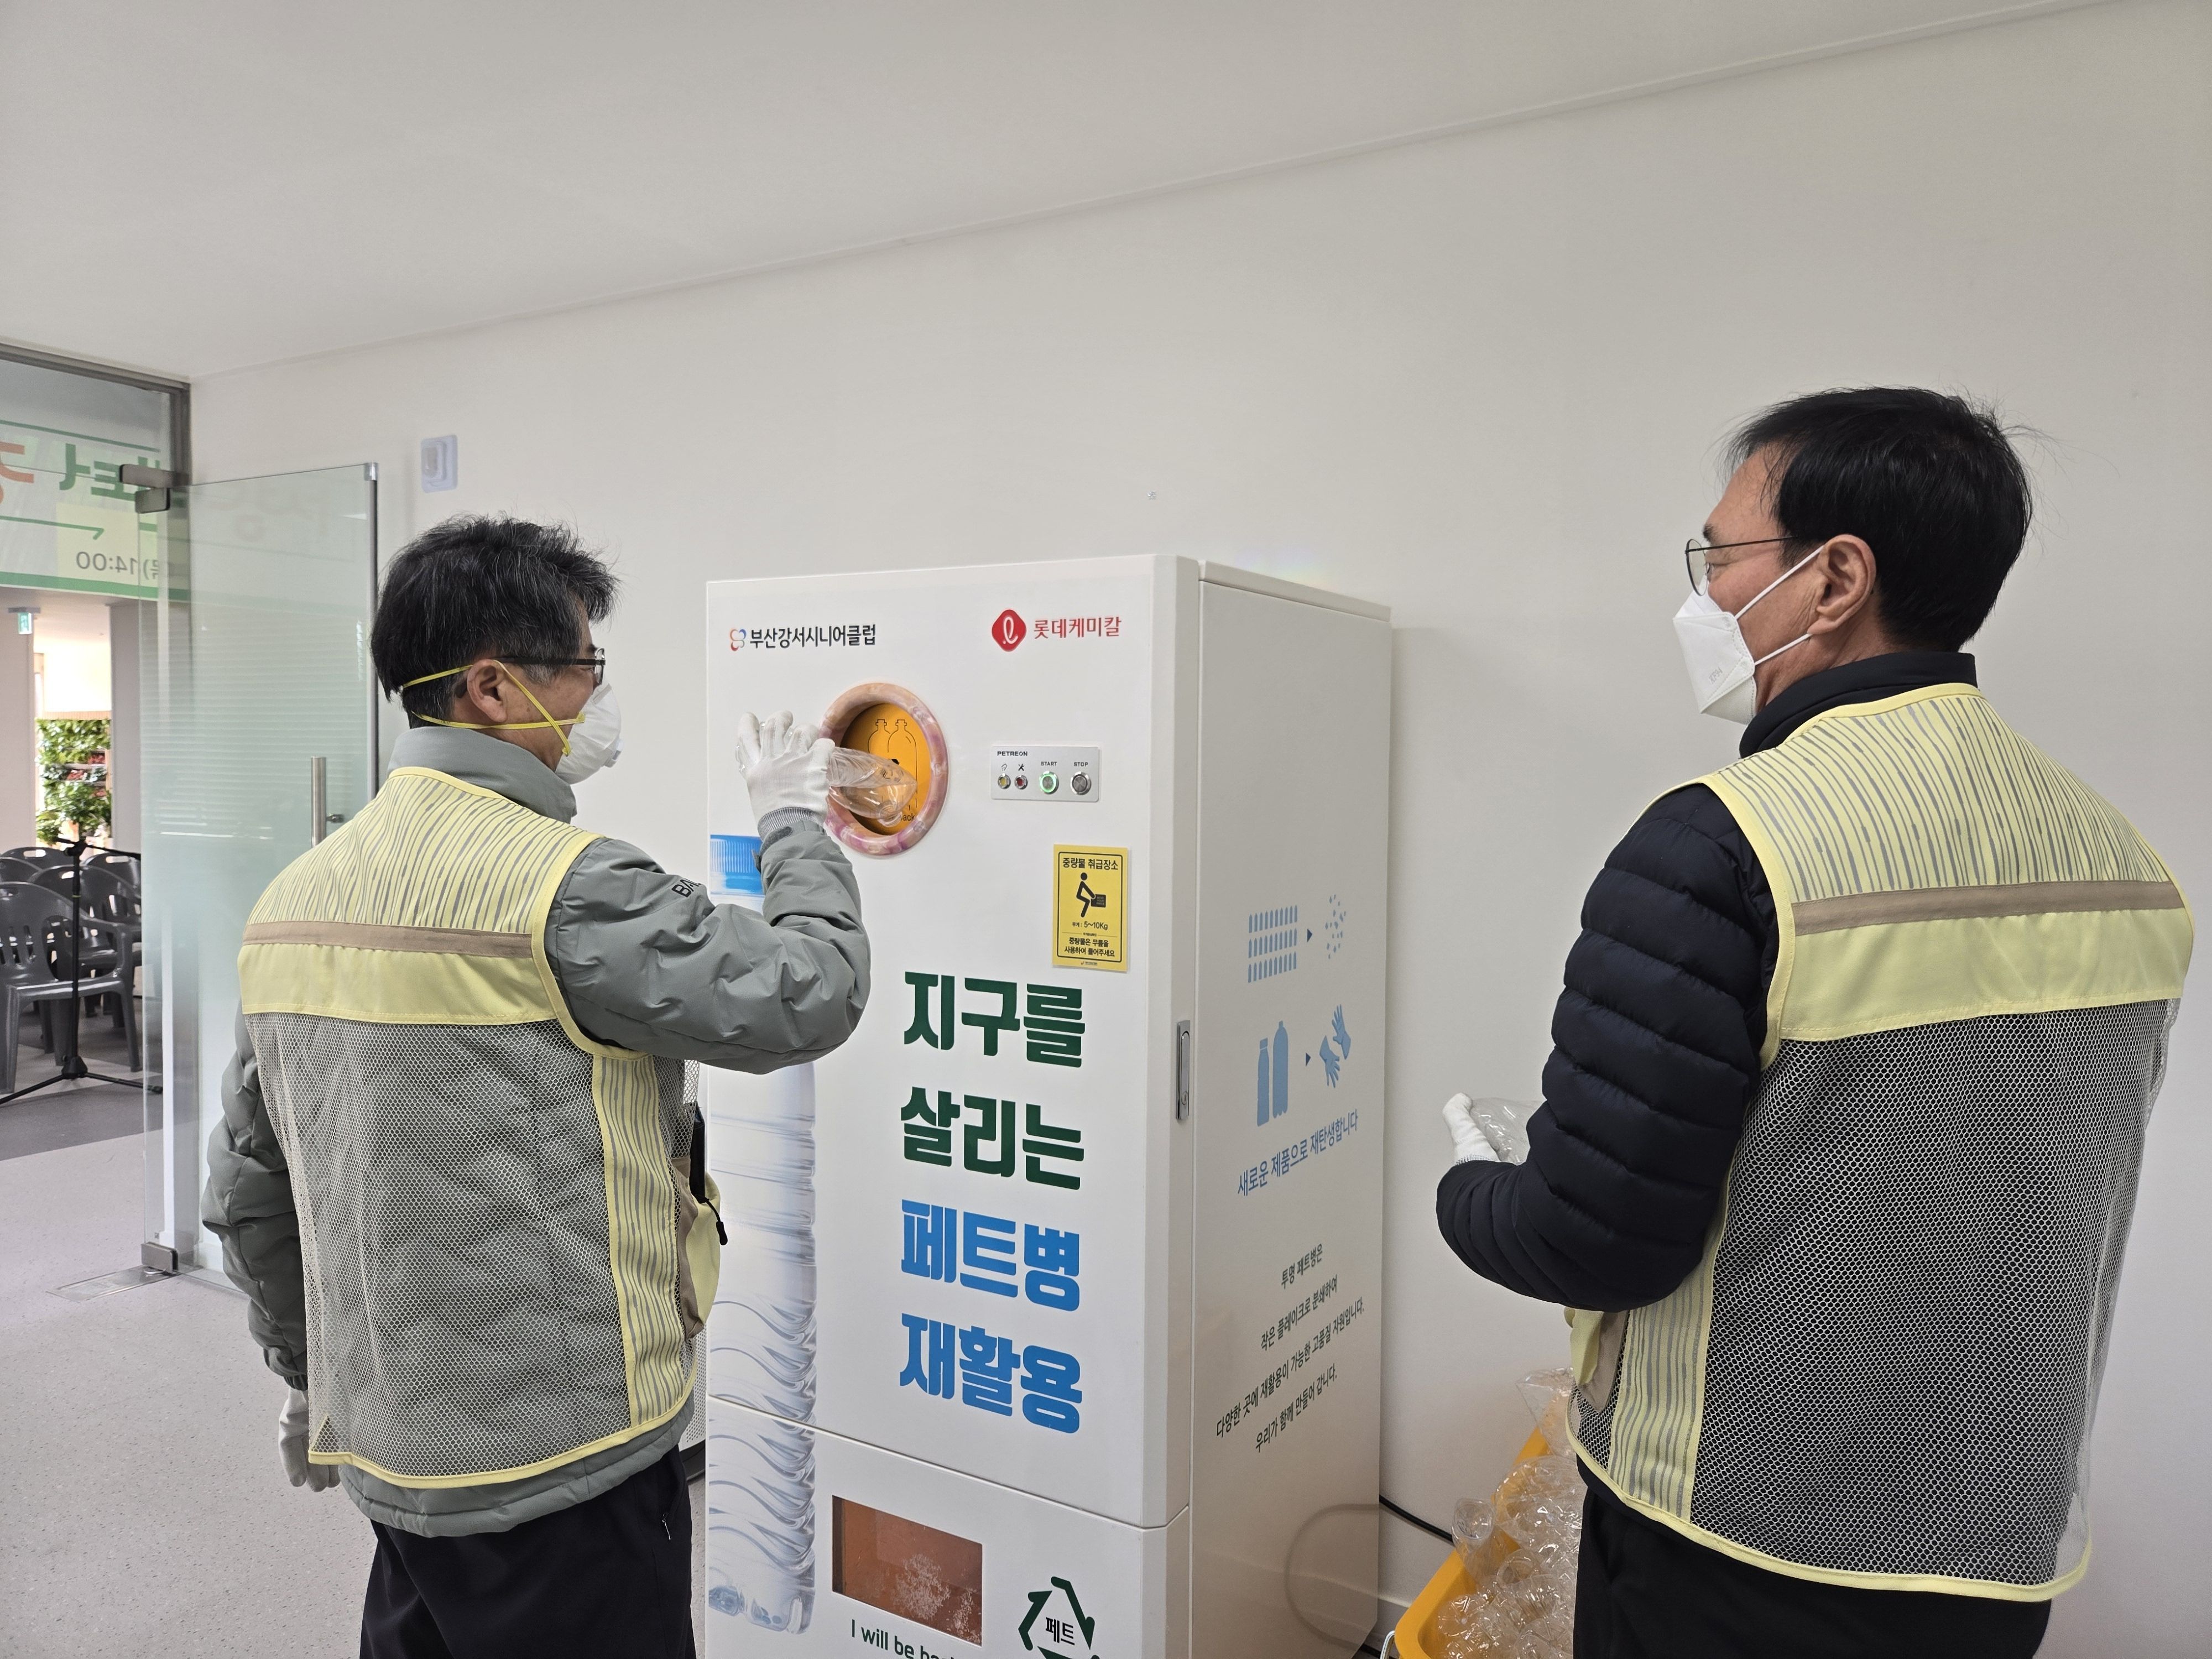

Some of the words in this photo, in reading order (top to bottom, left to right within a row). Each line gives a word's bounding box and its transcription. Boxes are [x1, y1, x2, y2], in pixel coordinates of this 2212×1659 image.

[750, 624, 876, 649] 부산강서시니어클럽
[1034, 617, 1122, 639] 롯데케미칼
[901, 813, 915, 821] ack
[1063, 857, 1086, 869] 중량물
[1088, 858, 1118, 870] 취급장소
[1069, 937, 1091, 946] 중량물은
[1092, 939, 1109, 947] 무릎을
[1084, 921, 1108, 931] 5~10Kg
[1065, 946, 1086, 954] 사용하여
[1088, 947, 1115, 957] 들어주세요
[904, 971, 1086, 1068] 지구를
[900, 1086, 1084, 1190] 살리는
[1238, 1161, 1269, 1196] 새로운
[1271, 1139, 1308, 1177] 제품으로
[1310, 1108, 1358, 1155] 재탄생합니다
[901, 1199, 1080, 1312] 페트병
[1281, 1263, 1295, 1289] 투명
[1297, 1243, 1323, 1275] 페트병은
[1261, 1326, 1275, 1351] 작은
[1277, 1297, 1311, 1340] 플레이크로
[1312, 1274, 1337, 1311] 분쇄하여
[900, 1312, 1082, 1434] 재활용
[1217, 1402, 1241, 1438] 다양한
[1243, 1387, 1259, 1418] 곳에
[1260, 1360, 1289, 1399] 재활용이
[1291, 1340, 1311, 1372] 가능한
[1312, 1324, 1331, 1354] 고품질
[1333, 1297, 1364, 1335] 자원입니다.
[1255, 1417, 1277, 1453] 우리가
[1280, 1401, 1293, 1431] 함께
[1296, 1384, 1315, 1416] 만들어
[1317, 1363, 1337, 1395] 갑니다.
[852, 1619, 855, 1638] I
[861, 1626, 888, 1651] will
[894, 1635, 915, 1659] be
[1045, 1616, 1075, 1646] 페트
